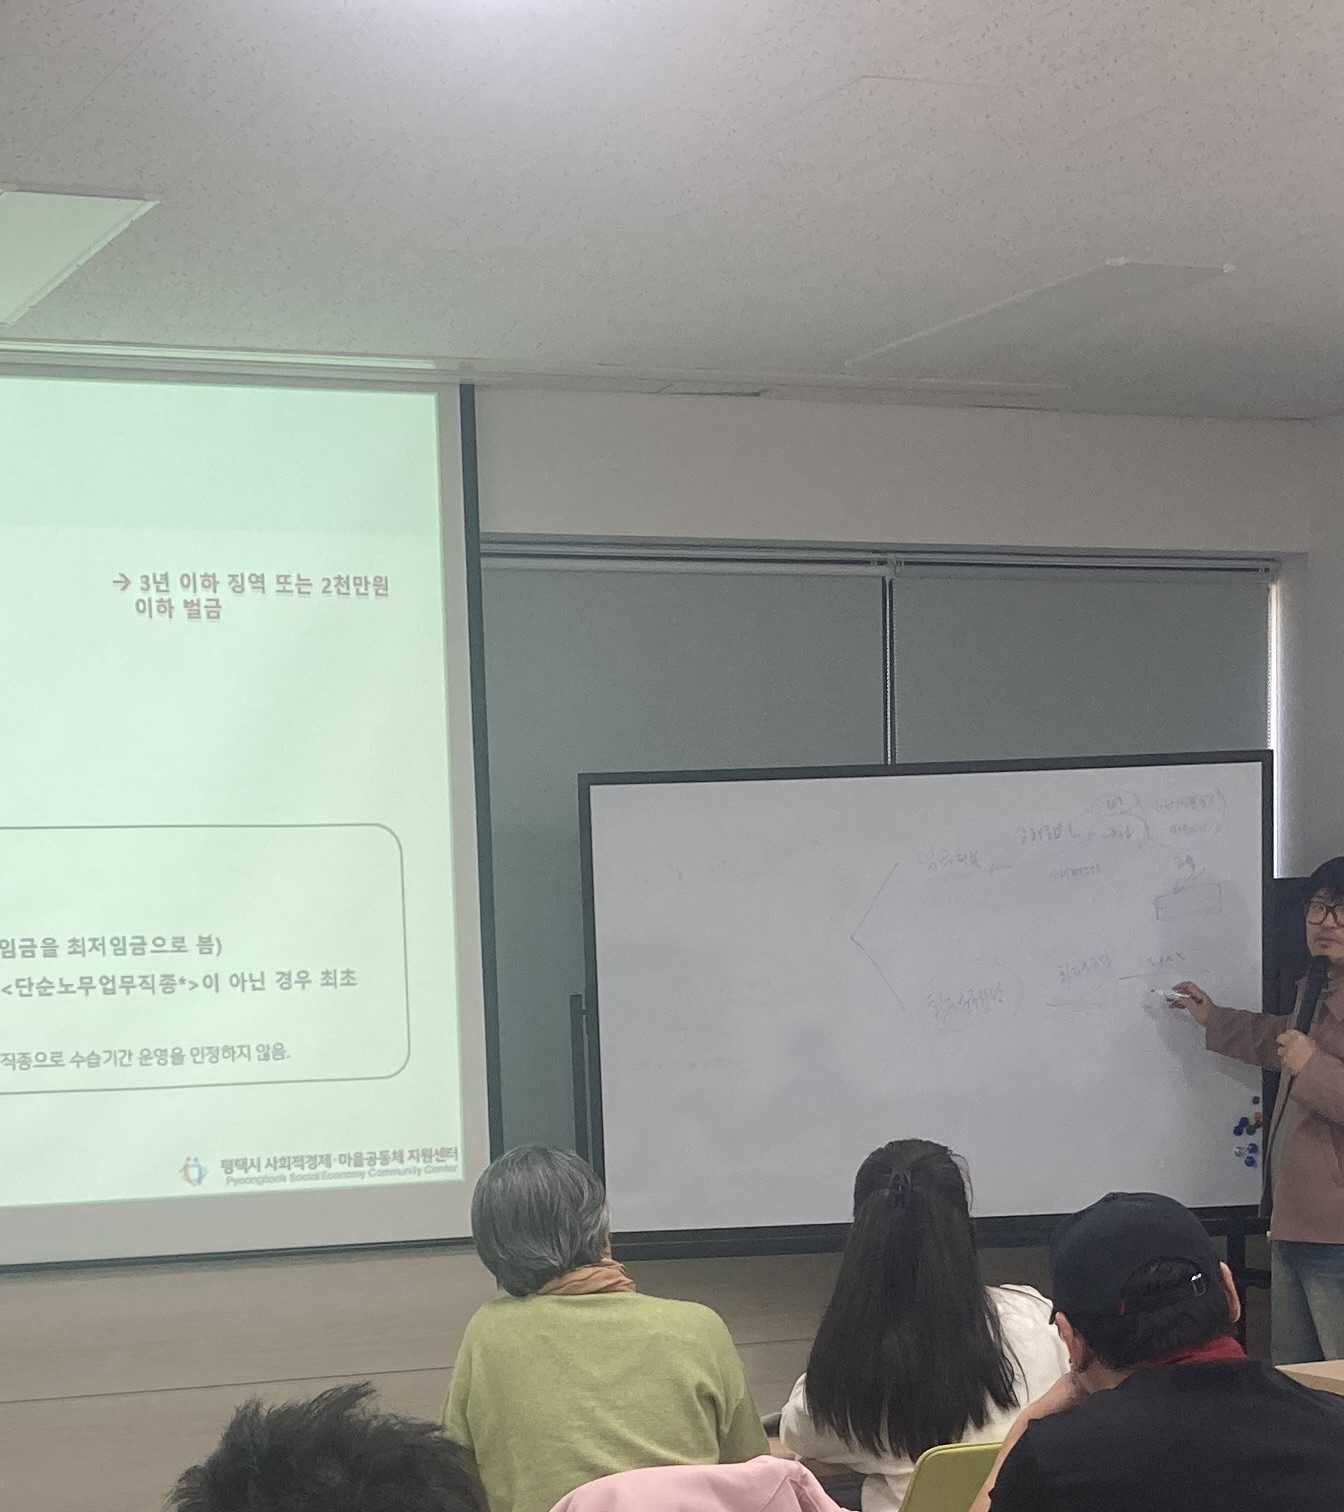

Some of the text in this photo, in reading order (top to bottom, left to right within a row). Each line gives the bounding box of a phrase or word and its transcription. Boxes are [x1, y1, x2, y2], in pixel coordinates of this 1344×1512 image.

[140, 572, 389, 597] 3년 이하 징역 또는 2천만원
[135, 597, 222, 619] 이하 벌금
[68, 935, 188, 958] 최저임금으로
[196, 934, 222, 957] 봄)
[229, 971, 265, 993] 아닌
[276, 970, 312, 990] 경우
[321, 968, 358, 989] 최초
[0, 1051, 66, 1071] 직종으로
[69, 1049, 134, 1068] 수습기간
[137, 1047, 186, 1066] 운영을
[190, 1045, 251, 1064] 인정하지
[256, 1042, 291, 1062] 않음.
[221, 1155, 261, 1175] 평택시
[409, 1146, 458, 1164] 지원센터
